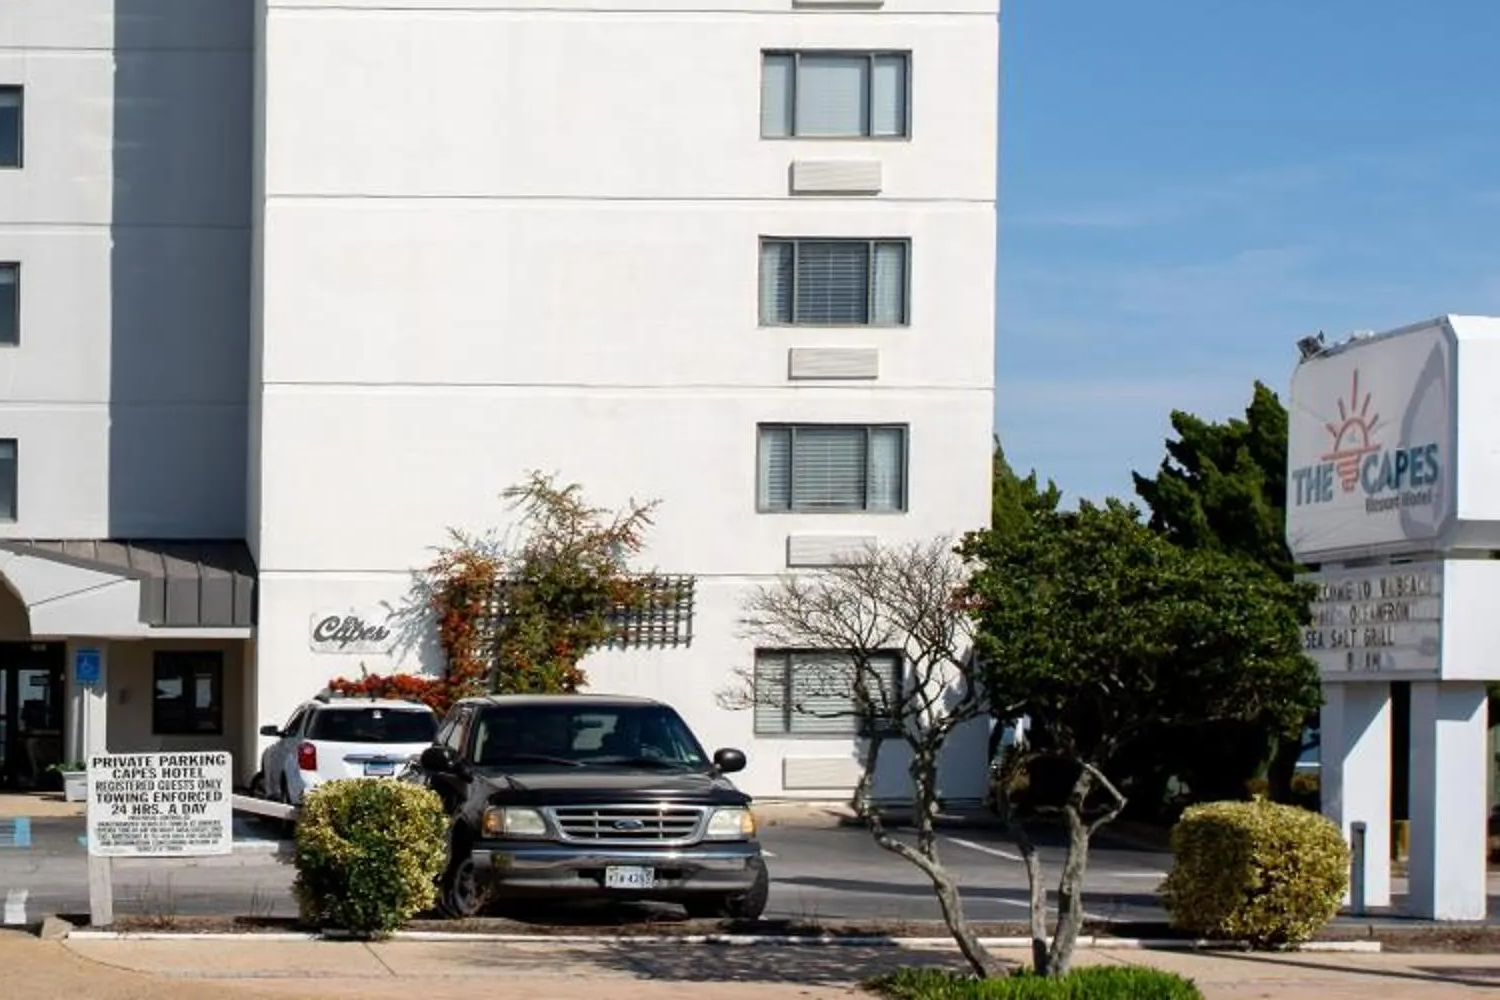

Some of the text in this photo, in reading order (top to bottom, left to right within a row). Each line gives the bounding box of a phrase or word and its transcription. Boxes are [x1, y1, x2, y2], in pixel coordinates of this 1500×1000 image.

[1292, 443, 1438, 507] THE CAPES
[1305, 625, 1395, 650] SEA SALT GRILL
[93, 754, 226, 768] PRIVATE PARKING
[112, 767, 206, 779] CAPES HOTEL
[95, 779, 222, 791] REGISTERED GUESTS ONLY
[95, 791, 222, 804] TOWING ENFORCED
[111, 803, 207, 815] 24 HRS. A DAY
